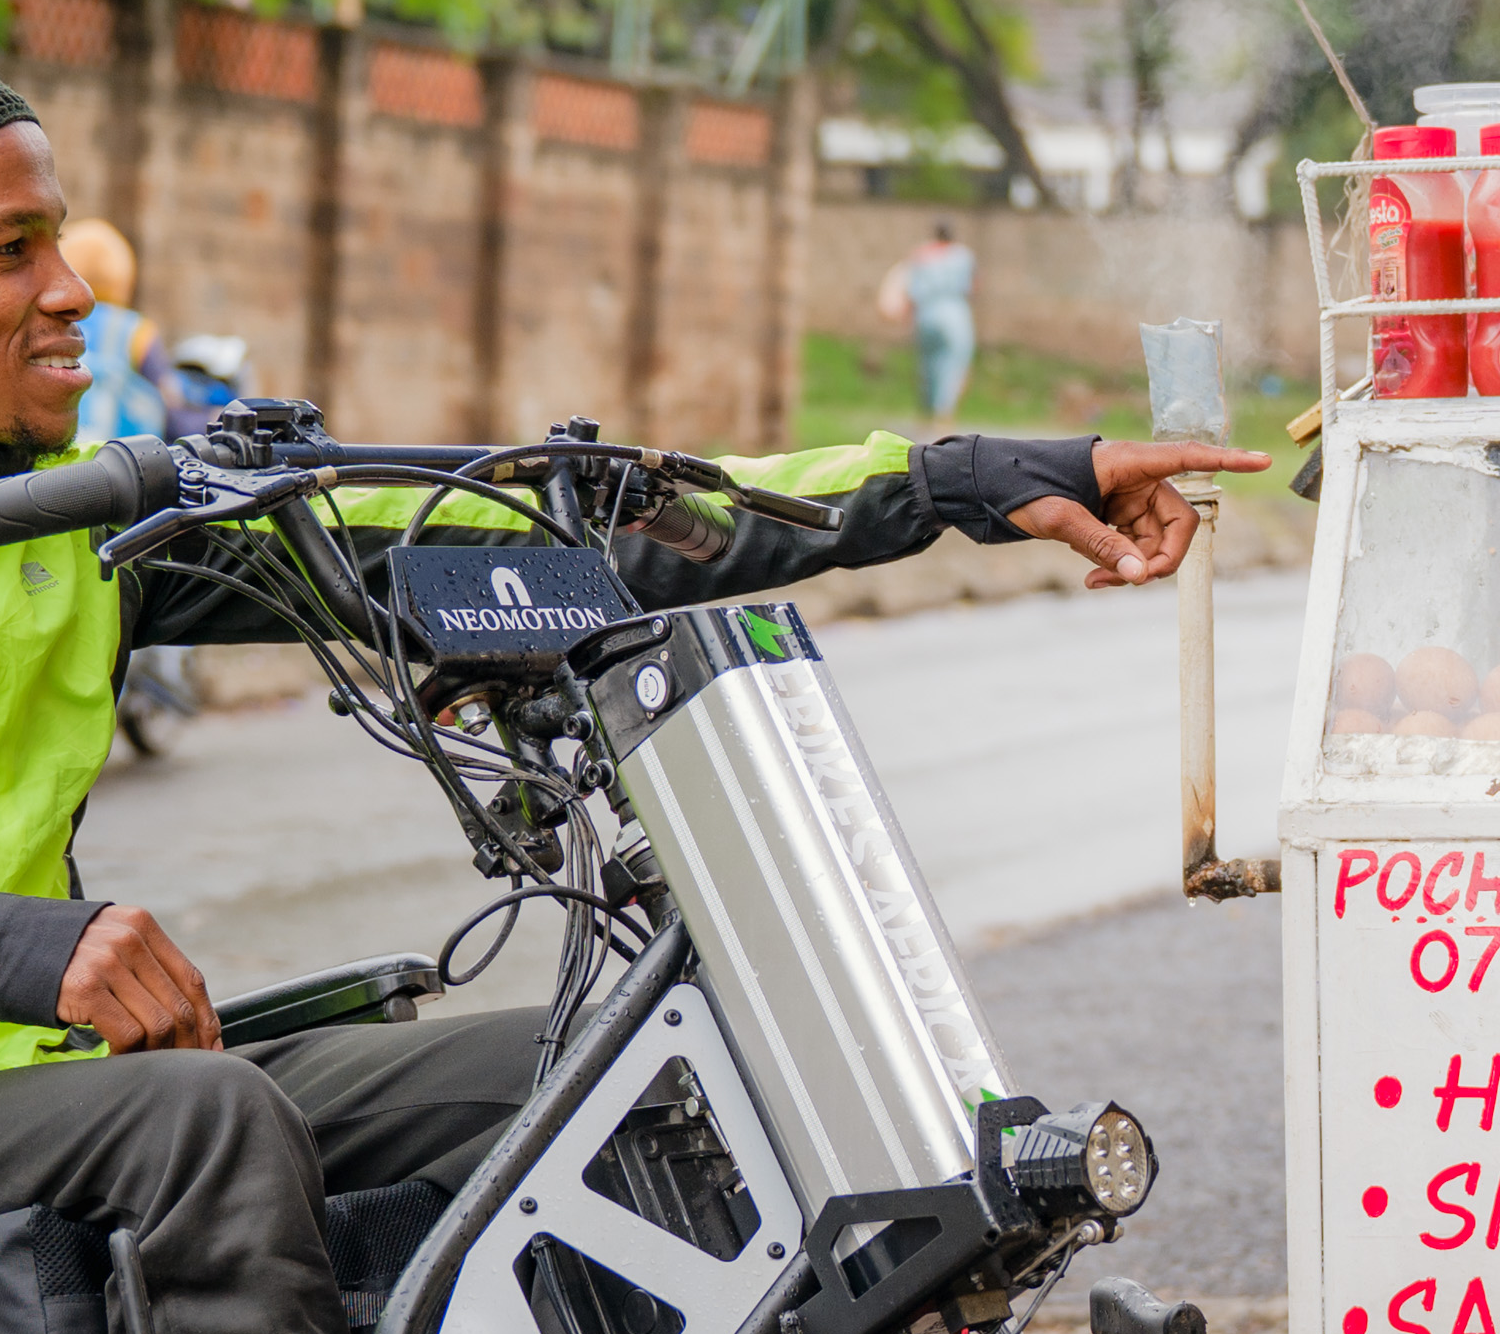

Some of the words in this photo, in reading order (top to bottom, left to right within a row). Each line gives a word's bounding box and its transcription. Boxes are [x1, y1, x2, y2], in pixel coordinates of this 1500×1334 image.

[437, 607, 608, 632] NEOMOTION
[761, 658, 895, 871] EBIKES
[862, 874, 995, 1096] AFRICA
